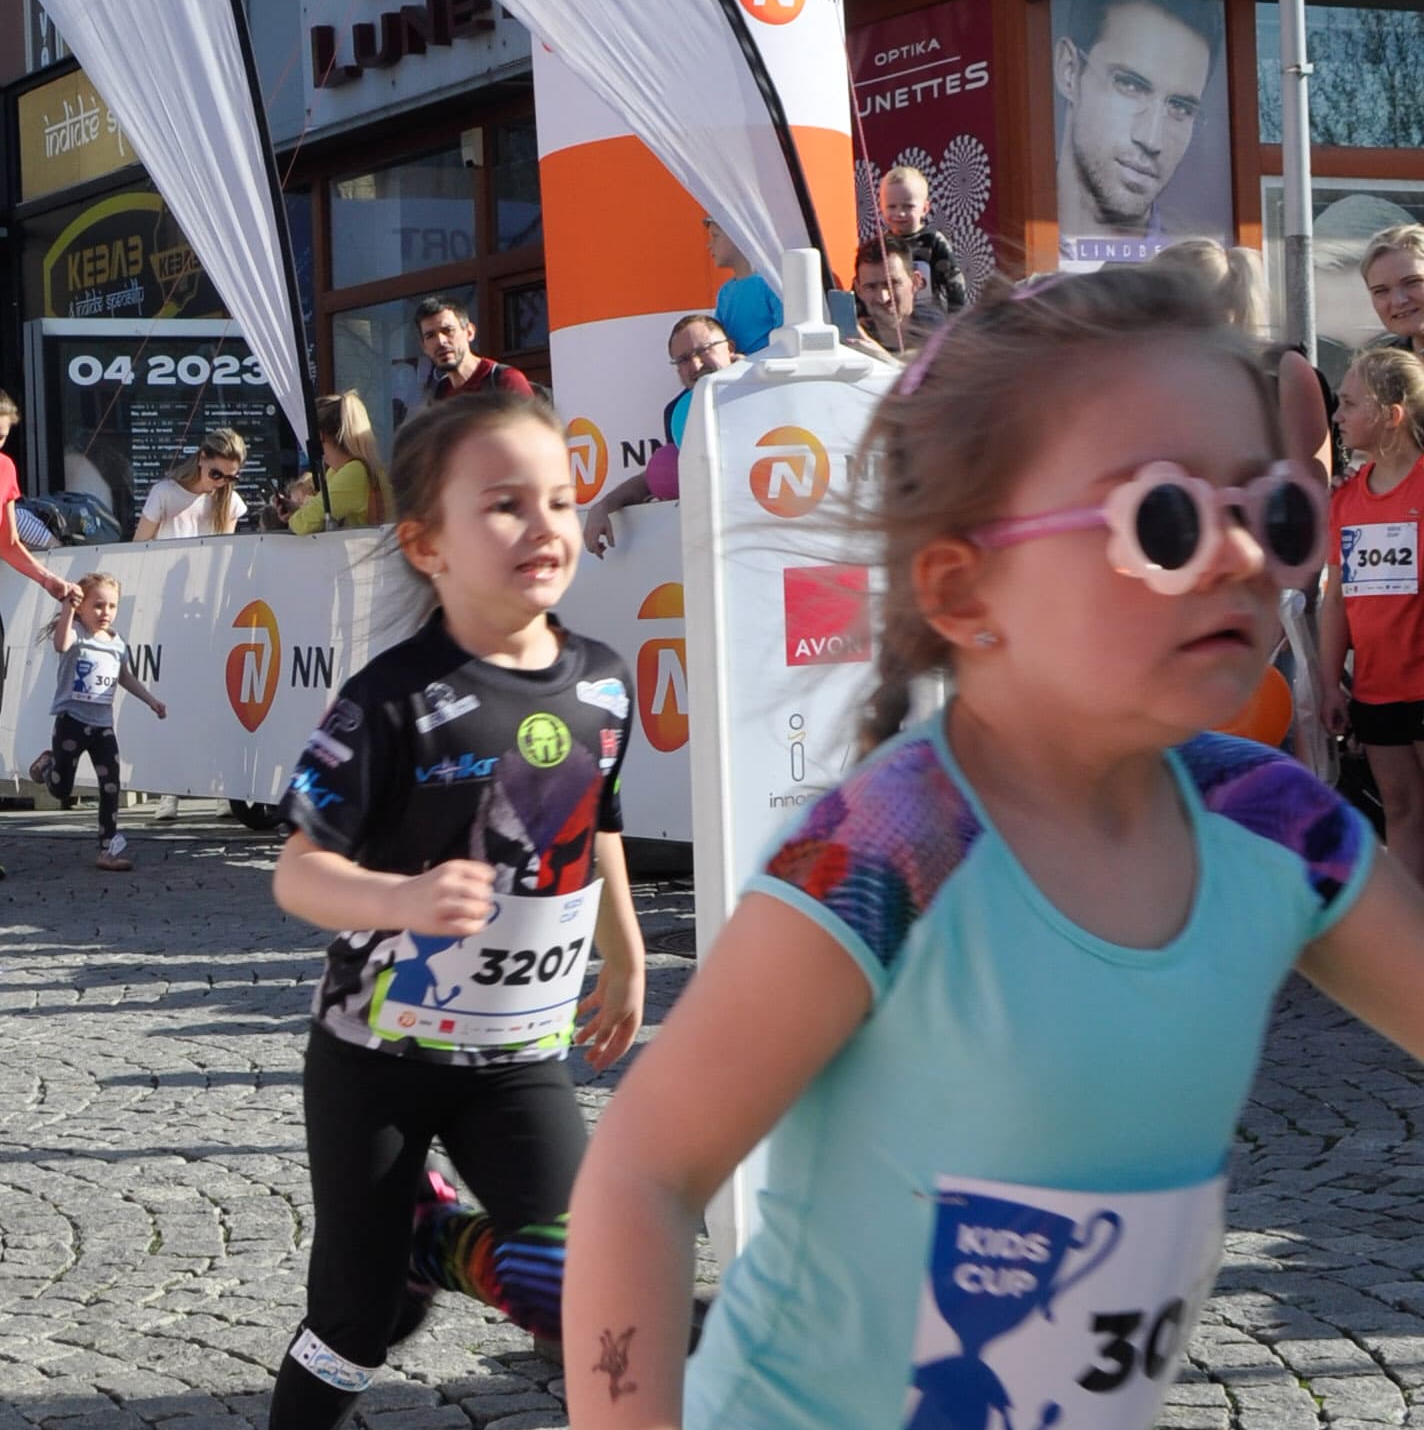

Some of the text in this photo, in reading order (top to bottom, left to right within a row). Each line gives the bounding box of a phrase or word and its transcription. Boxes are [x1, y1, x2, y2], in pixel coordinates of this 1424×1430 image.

[874, 38, 941, 67] OPTIKA
[857, 60, 990, 118] UNETTES
[67, 355, 134, 387] 04
[147, 355, 270, 387] 2023
[1357, 547, 1413, 568] 3042
[291, 646, 335, 688] NN
[471, 936, 586, 986] 3207
[954, 1222, 1053, 1264] KIDS
[952, 1262, 1039, 1299] CUP
